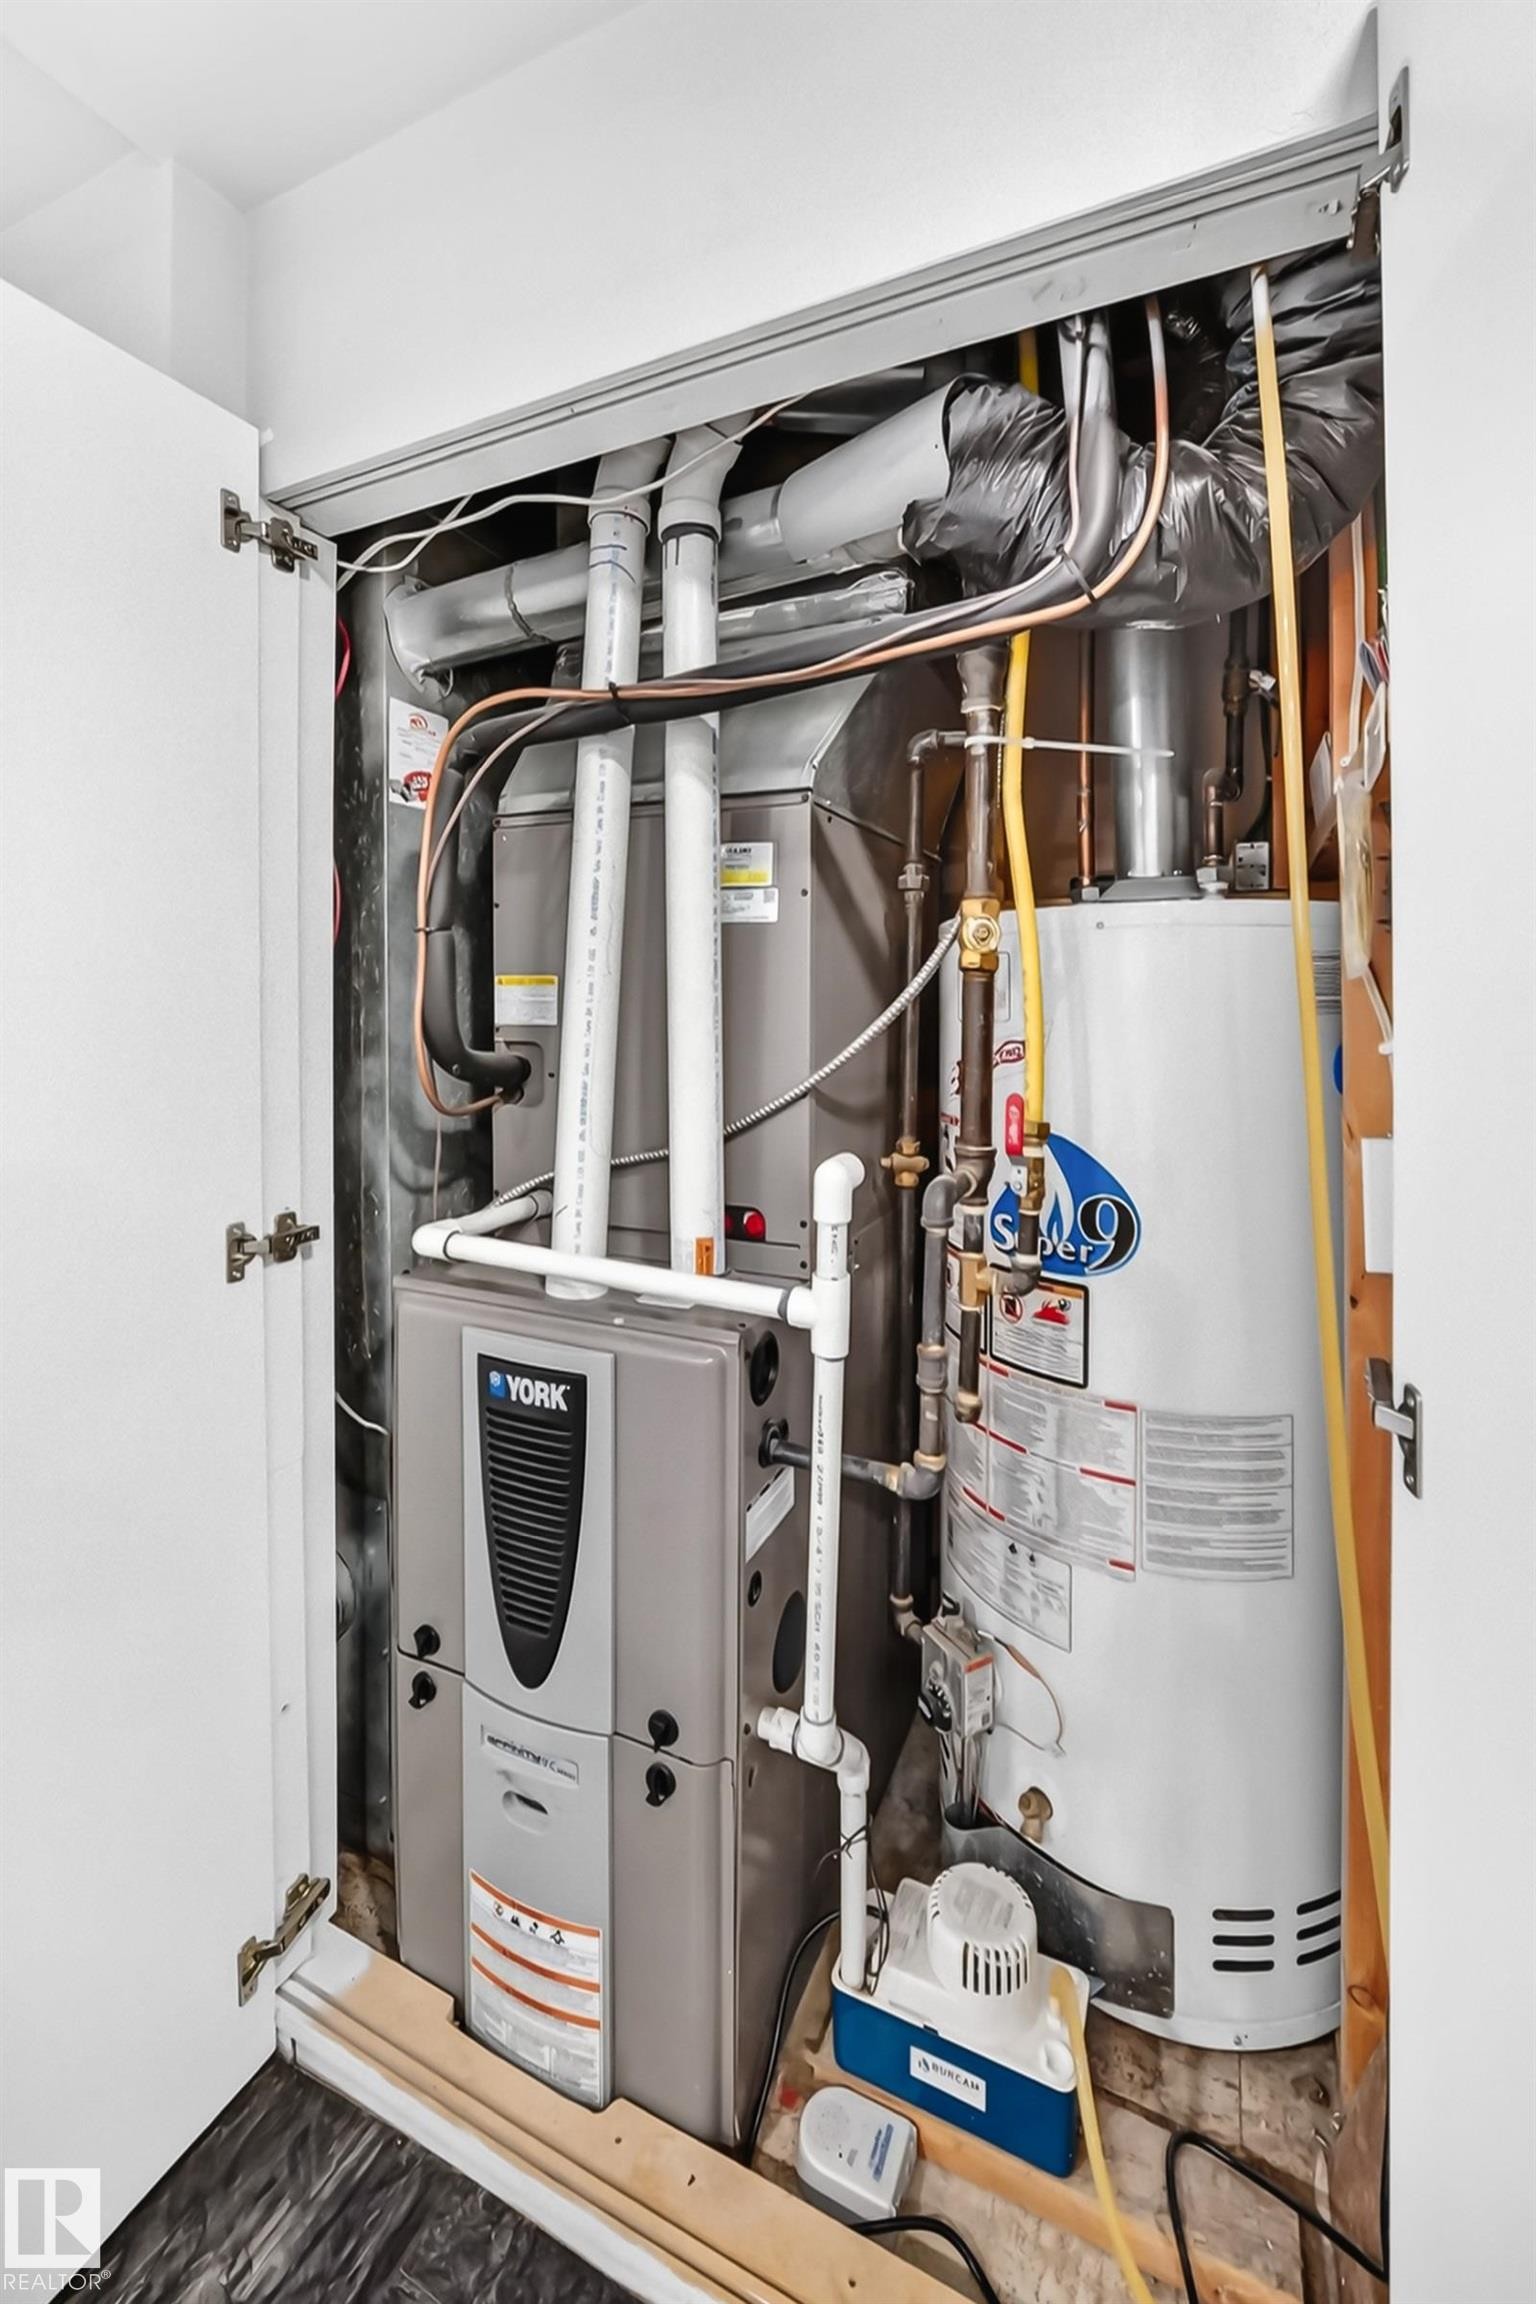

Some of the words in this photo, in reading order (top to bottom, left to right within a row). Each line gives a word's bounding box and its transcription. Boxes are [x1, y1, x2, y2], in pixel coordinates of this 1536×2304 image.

[993, 1213, 1094, 1263] Sper
[1077, 1193, 1138, 1273] 9
[505, 1374, 568, 1412] YORK
